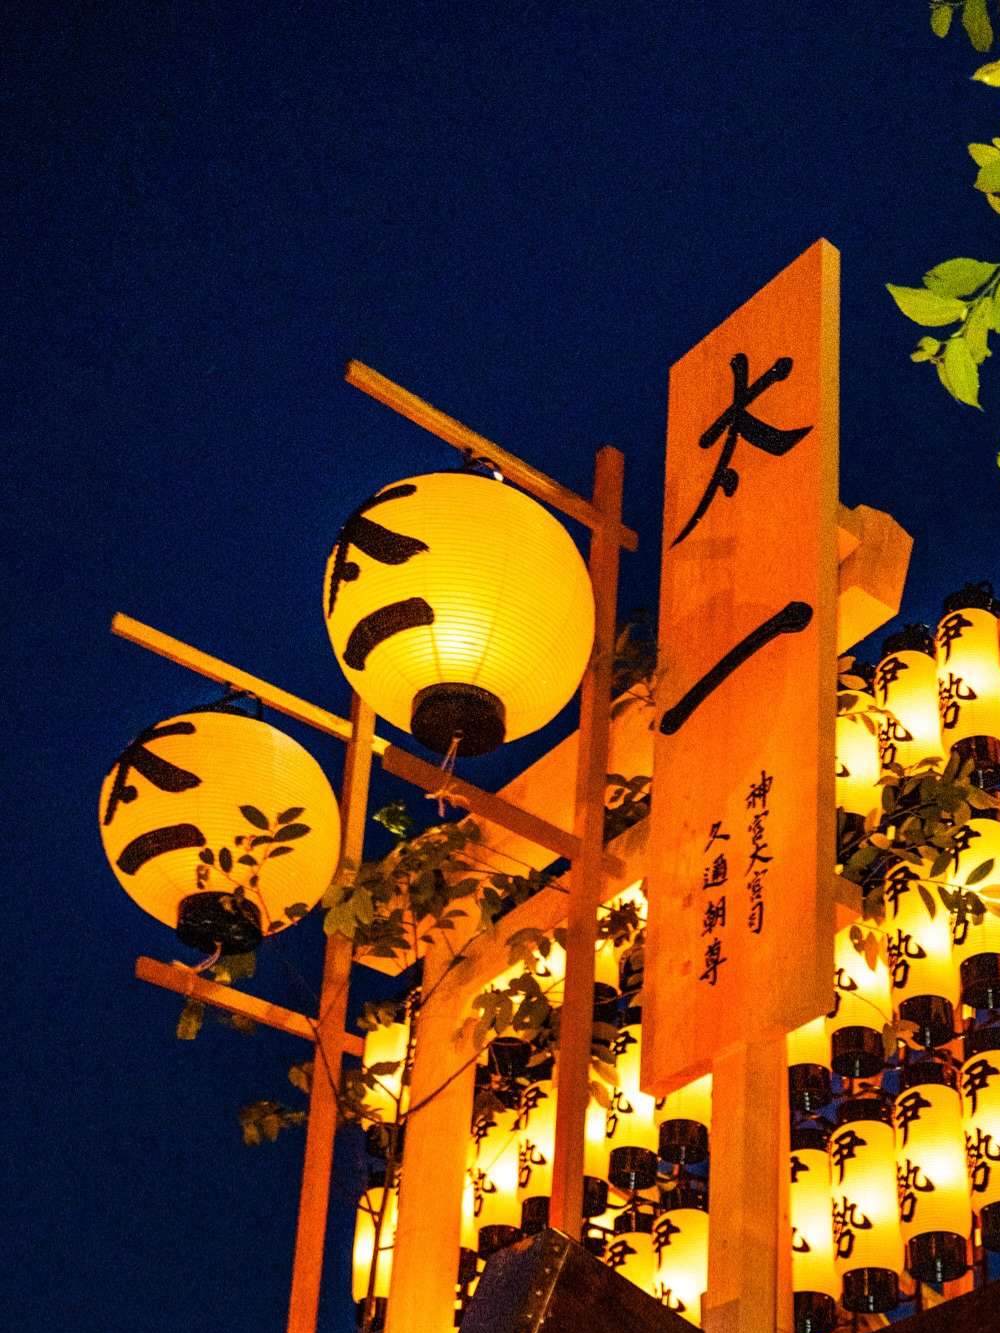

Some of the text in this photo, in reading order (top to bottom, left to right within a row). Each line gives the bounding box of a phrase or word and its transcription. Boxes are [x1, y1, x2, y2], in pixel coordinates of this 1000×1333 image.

[663, 353, 814, 737] 太一
[745, 770, 774, 935] 神宮大宮司
